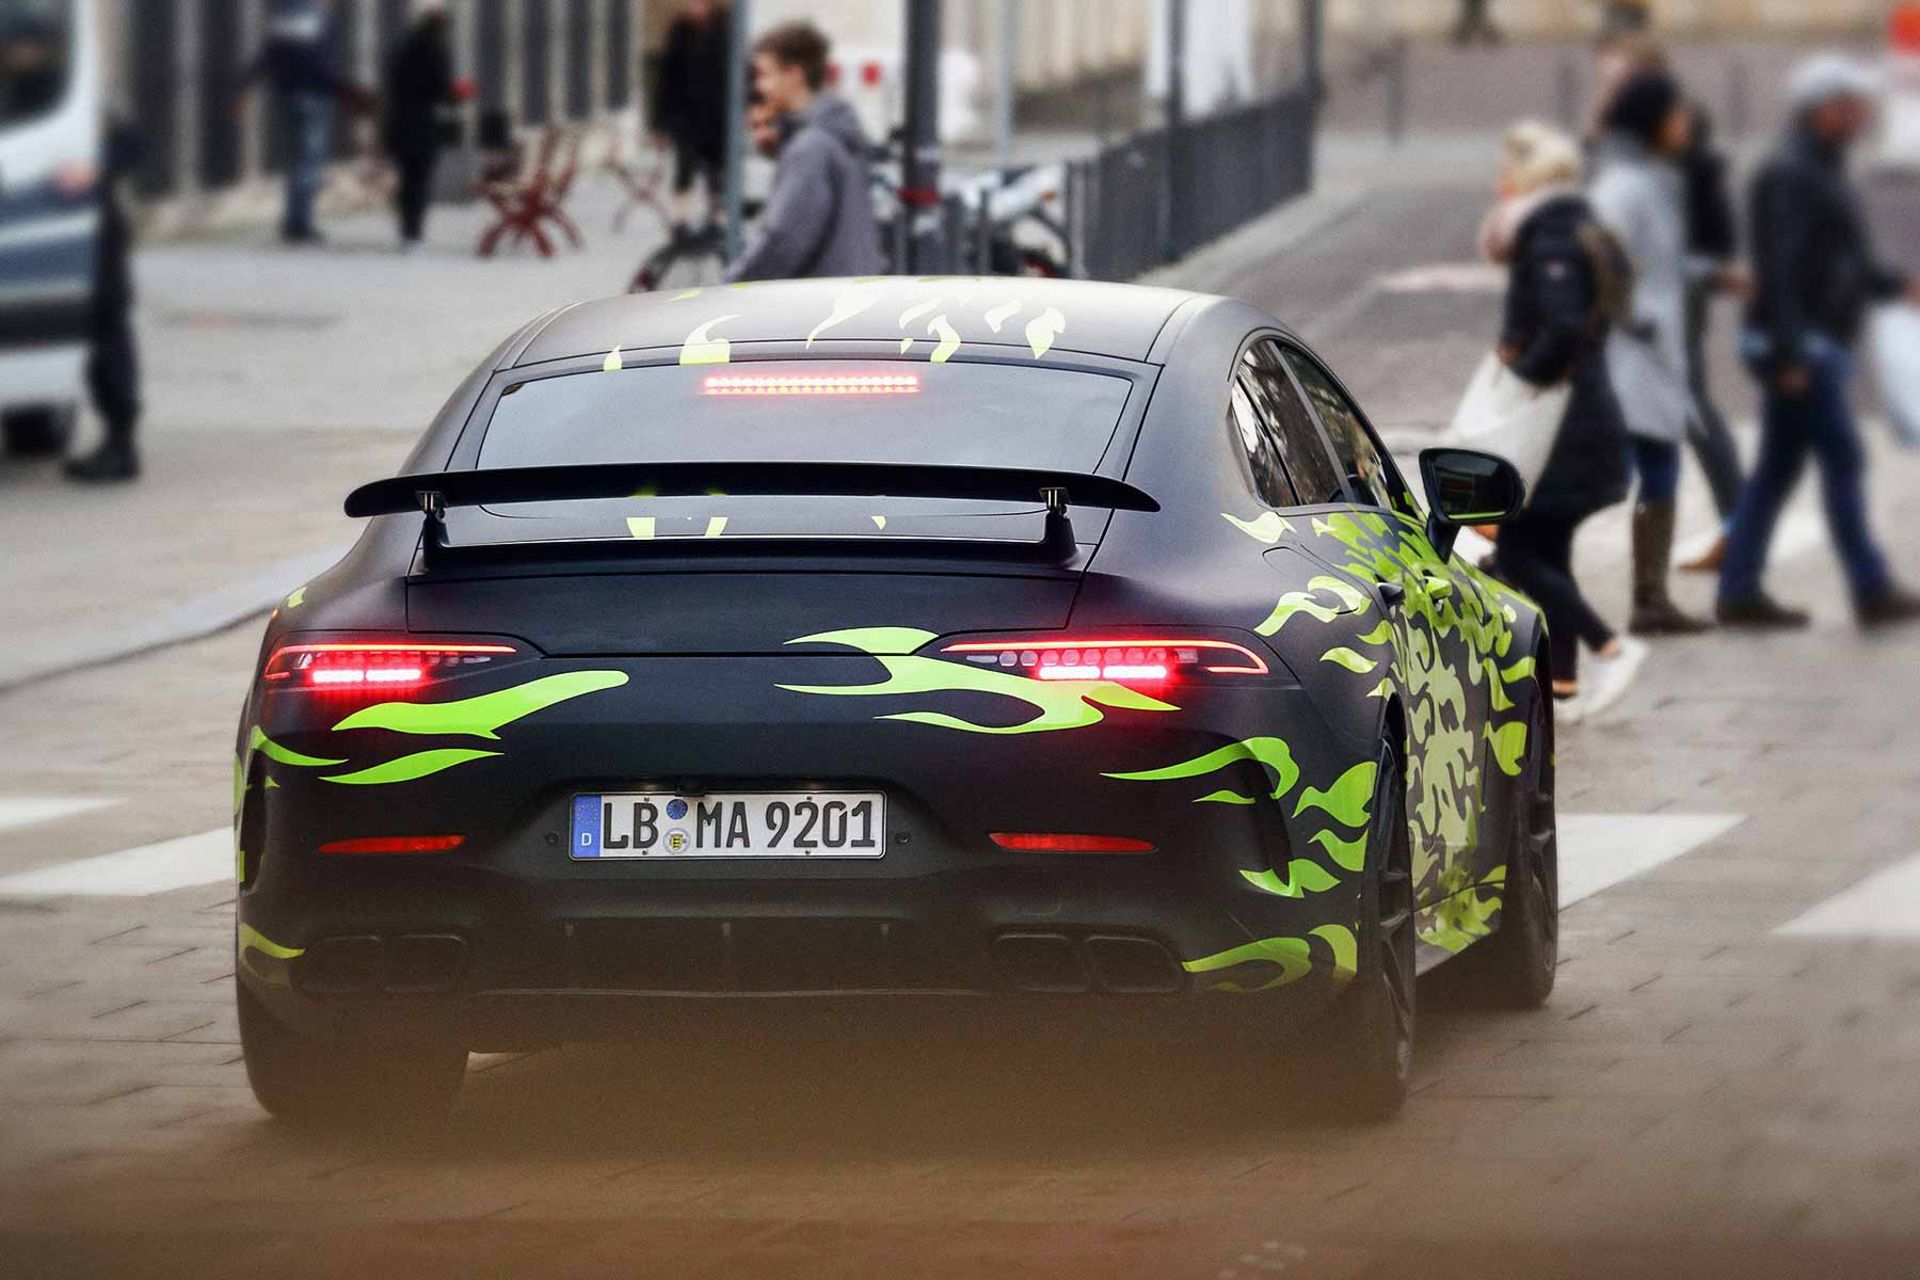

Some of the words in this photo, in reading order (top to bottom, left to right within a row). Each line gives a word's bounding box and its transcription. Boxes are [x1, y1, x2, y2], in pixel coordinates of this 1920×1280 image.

[580, 832, 592, 846] D
[603, 802, 659, 849] LB
[696, 801, 751, 849] MA
[765, 800, 876, 849] 9201
